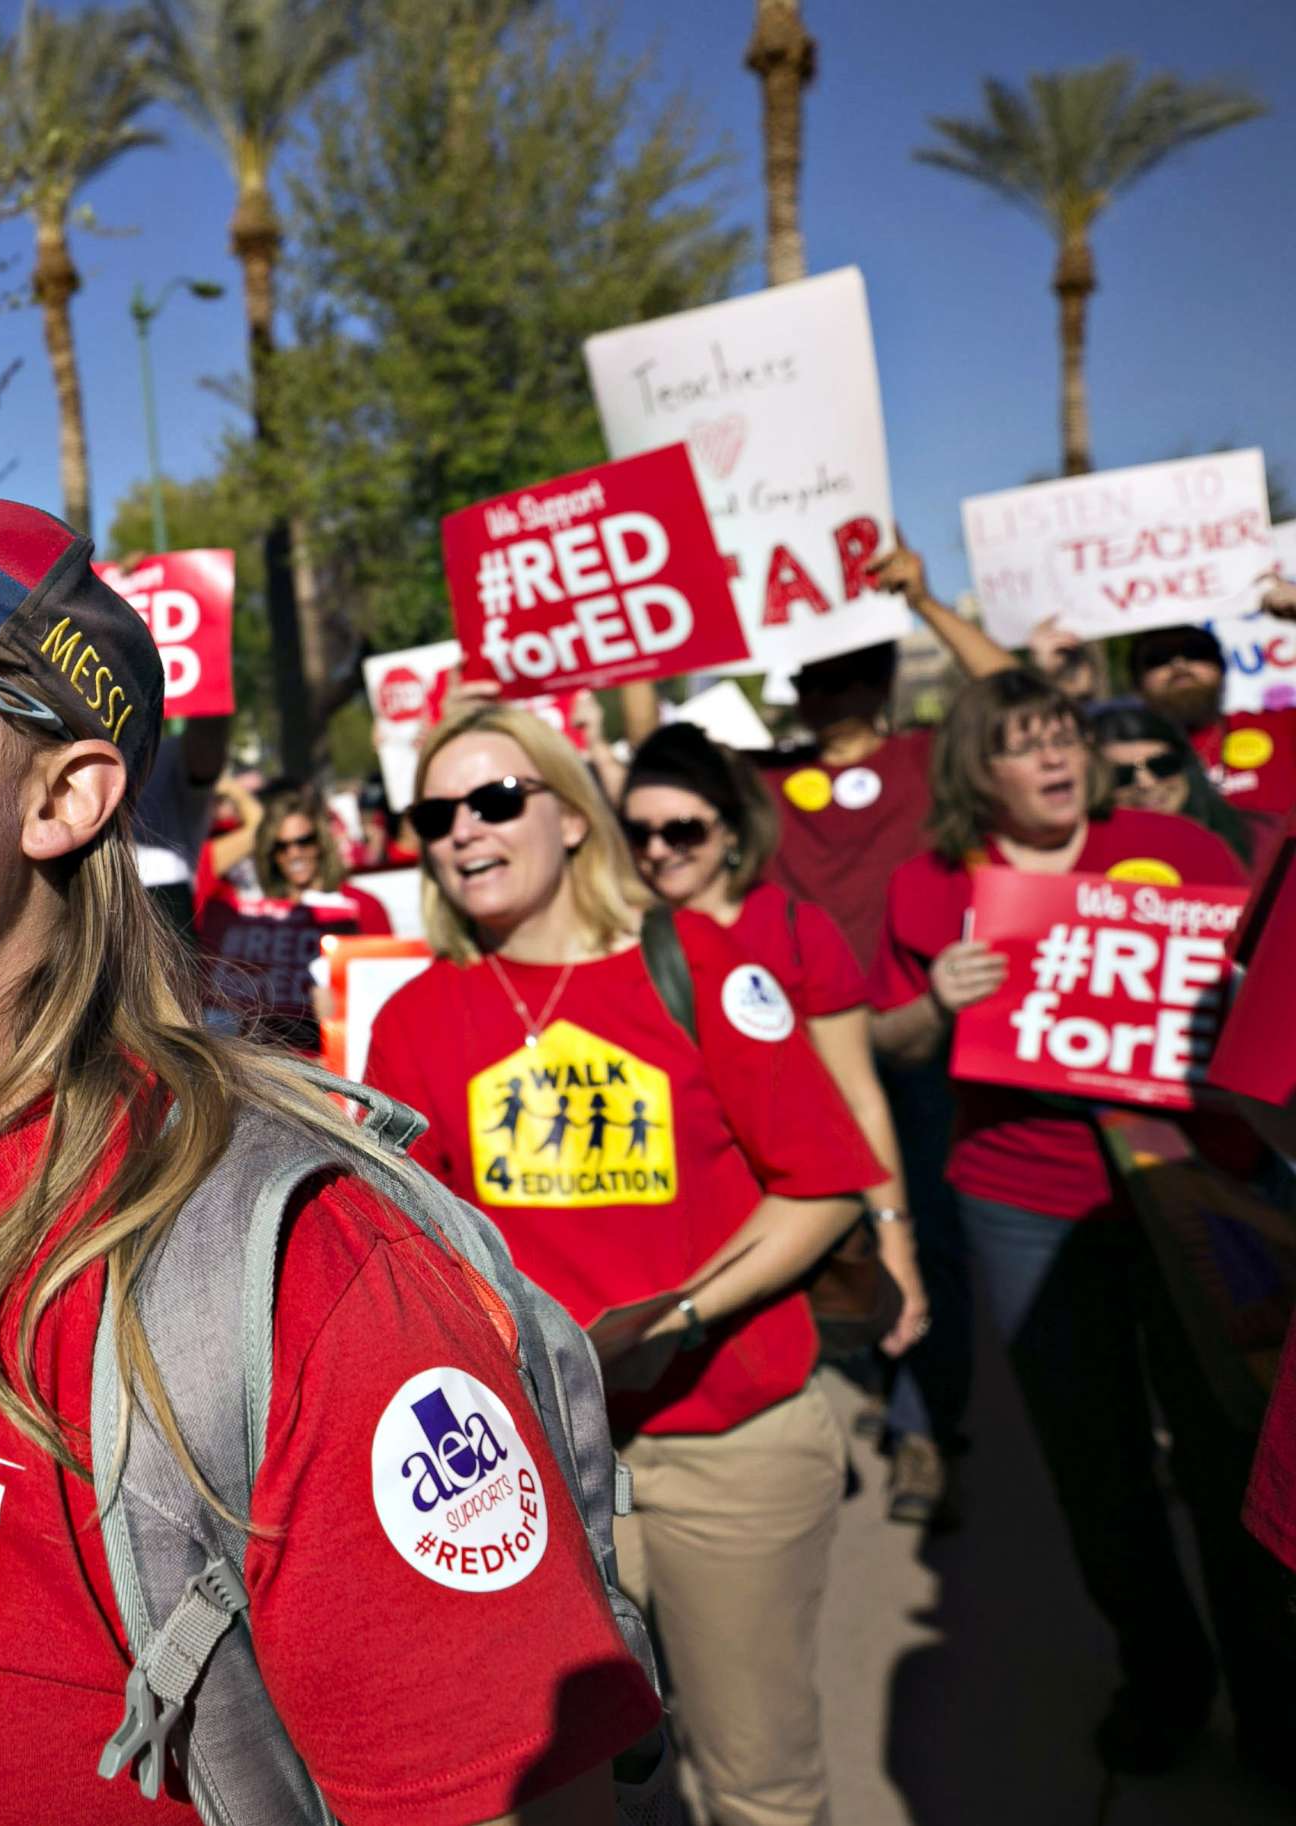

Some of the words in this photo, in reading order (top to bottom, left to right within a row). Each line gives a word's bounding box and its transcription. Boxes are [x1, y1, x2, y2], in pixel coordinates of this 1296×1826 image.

[632, 341, 798, 418] Teachers
[518, 481, 606, 532] Support
[1171, 469, 1224, 504] TO
[476, 511, 671, 617] #RED
[722, 515, 882, 629] AR
[1102, 564, 1219, 611] VOICE
[481, 584, 694, 683] forED
[39, 616, 134, 744] MESSI
[1075, 883, 1127, 919] We
[1132, 887, 1243, 934] Suppor
[1031, 924, 1226, 1006] #RE
[530, 1061, 628, 1089] WALK
[1010, 991, 1211, 1083] forE
[485, 1156, 514, 1193] 4
[520, 1168, 670, 1196] EDUCATION
[401, 1412, 508, 1513] aea
[414, 1468, 538, 1575] #REDforED
